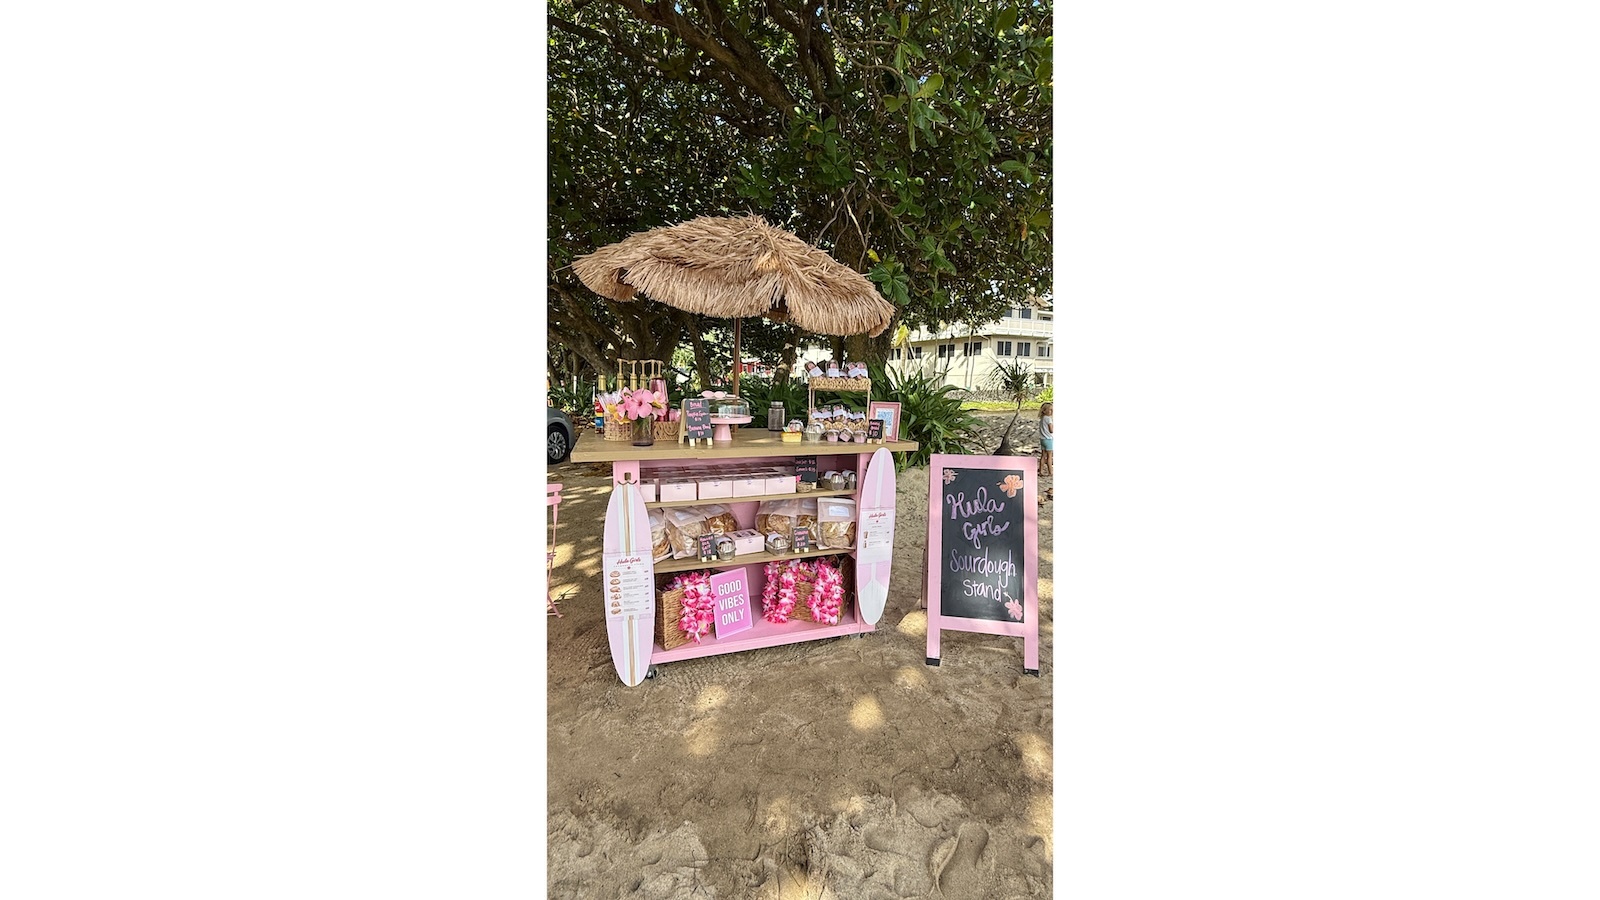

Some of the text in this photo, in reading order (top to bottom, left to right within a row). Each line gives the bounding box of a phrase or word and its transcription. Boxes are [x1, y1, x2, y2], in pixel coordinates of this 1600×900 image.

[946, 486, 1005, 520] Hula
[963, 515, 1010, 549] Girls
[950, 546, 1017, 588] Sourdough
[718, 579, 742, 596] GOOD
[963, 579, 1002, 602] Stand
[719, 593, 745, 611] VIBES
[722, 608, 744, 626] ONLY
